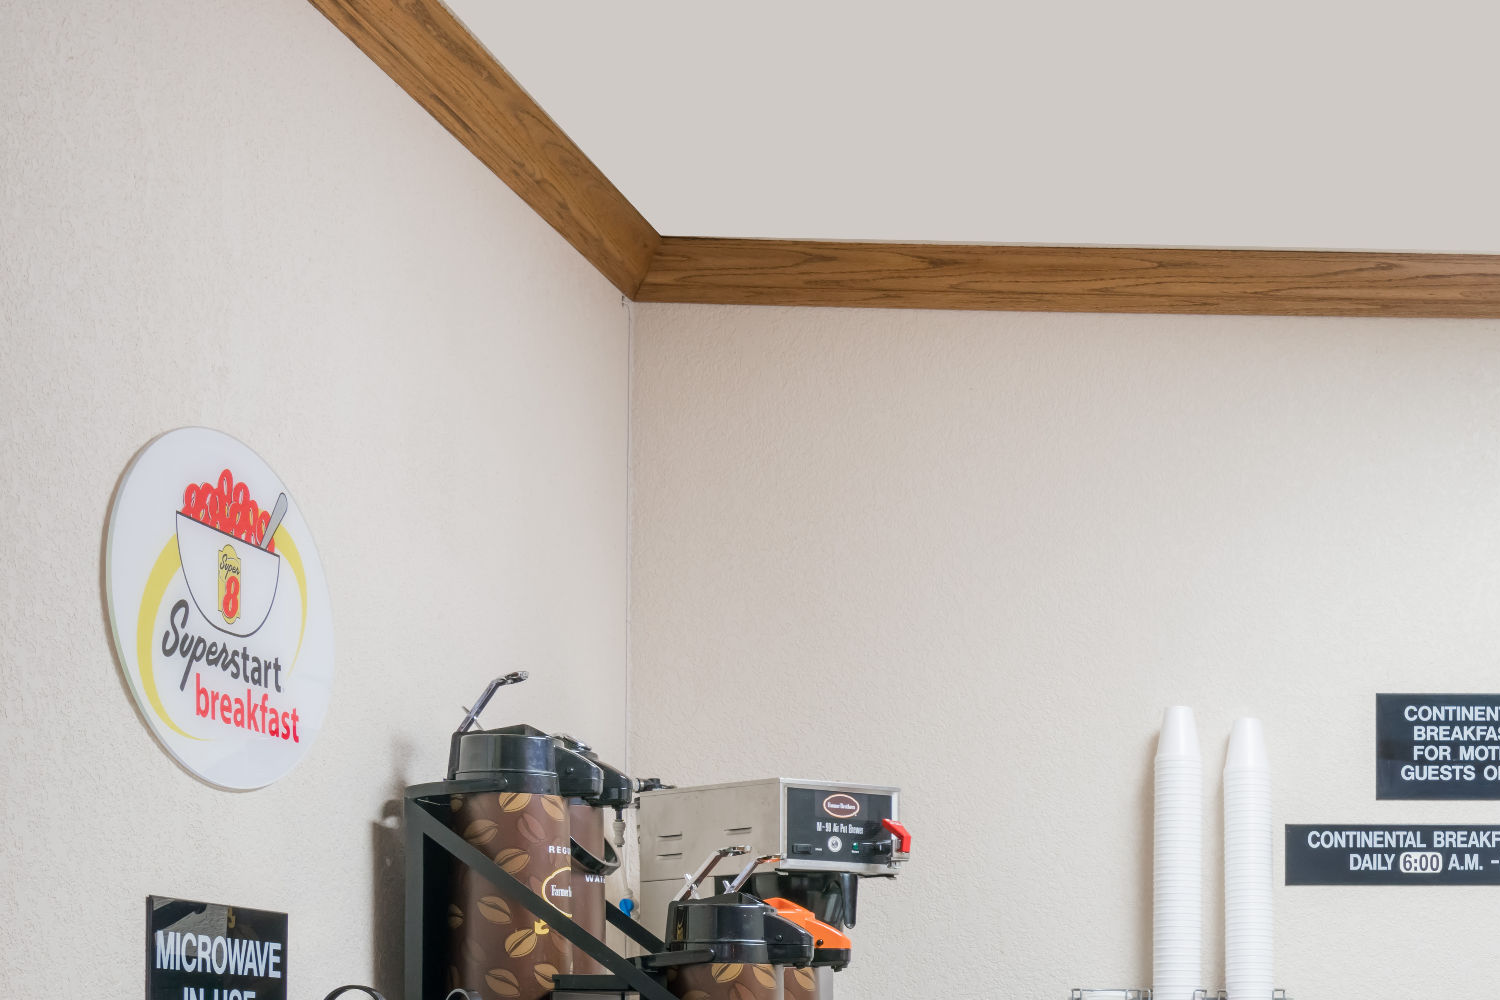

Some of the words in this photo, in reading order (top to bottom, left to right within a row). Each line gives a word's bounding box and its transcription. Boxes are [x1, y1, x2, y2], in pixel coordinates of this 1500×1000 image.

[219, 553, 241, 580] Super
[222, 575, 240, 619] 8
[161, 599, 282, 693] Superstart
[195, 673, 300, 743] breakfast
[1413, 745, 1451, 761] FOR
[1400, 765, 1475, 781] GUESTS
[1307, 830, 1427, 849] CONTINENTAL
[1349, 853, 1396, 871] DAILY
[1402, 853, 1440, 872] 6:00
[1448, 853, 1484, 871] A.M.
[156, 930, 282, 979] MICROWAVE
